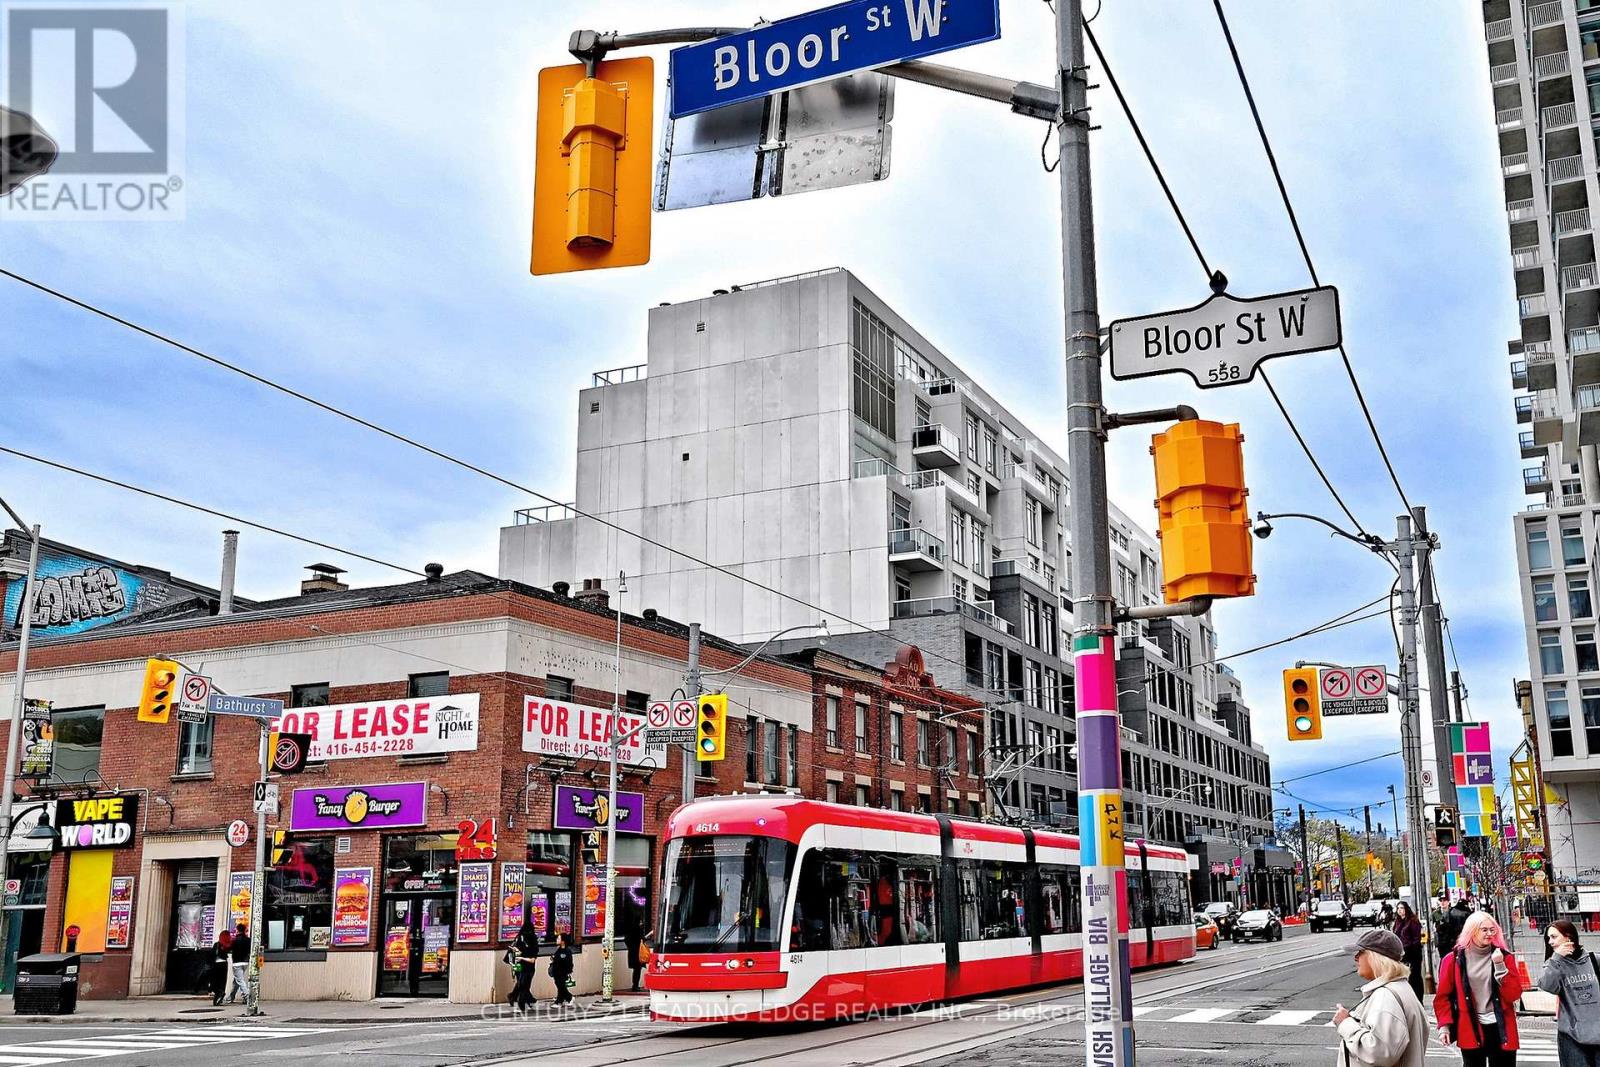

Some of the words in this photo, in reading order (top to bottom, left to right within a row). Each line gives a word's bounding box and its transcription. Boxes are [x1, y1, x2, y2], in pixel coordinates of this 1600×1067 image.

[714, 25, 848, 91] Bloor
[866, 5, 892, 31] St
[905, 0, 943, 42] W
[1143, 322, 1226, 358] Bloor
[1236, 312, 1267, 345] St
[1278, 304, 1306, 338] W
[1208, 365, 1241, 382] 558
[216, 697, 266, 713] Bathurst
[1325, 706, 1354, 715] EXCEPTED
[1357, 705, 1386, 714] EXCEPTED
[270, 712, 319, 742] FOR
[333, 703, 430, 740] LEASE
[435, 711, 463, 722] RIGHT
[526, 701, 569, 738] FOR
[578, 710, 640, 748] LEASE
[438, 720, 474, 739] HOME
[326, 739, 414, 756] 416-454-2228
[540, 737, 571, 753] Direct:
[73, 798, 124, 822] VAPE
[318, 803, 343, 817] Fancy
[369, 800, 400, 815] Burger
[61, 823, 131, 847] WORLD
[233, 824, 246, 836] 24
[457, 818, 497, 848] 24
[696, 823, 720, 832] 4614
[505, 883, 522, 893] TWIN
[1088, 916, 1108, 944] BIA
[790, 955, 803, 964] 4614
[1090, 954, 1111, 1022] VILLAGE
